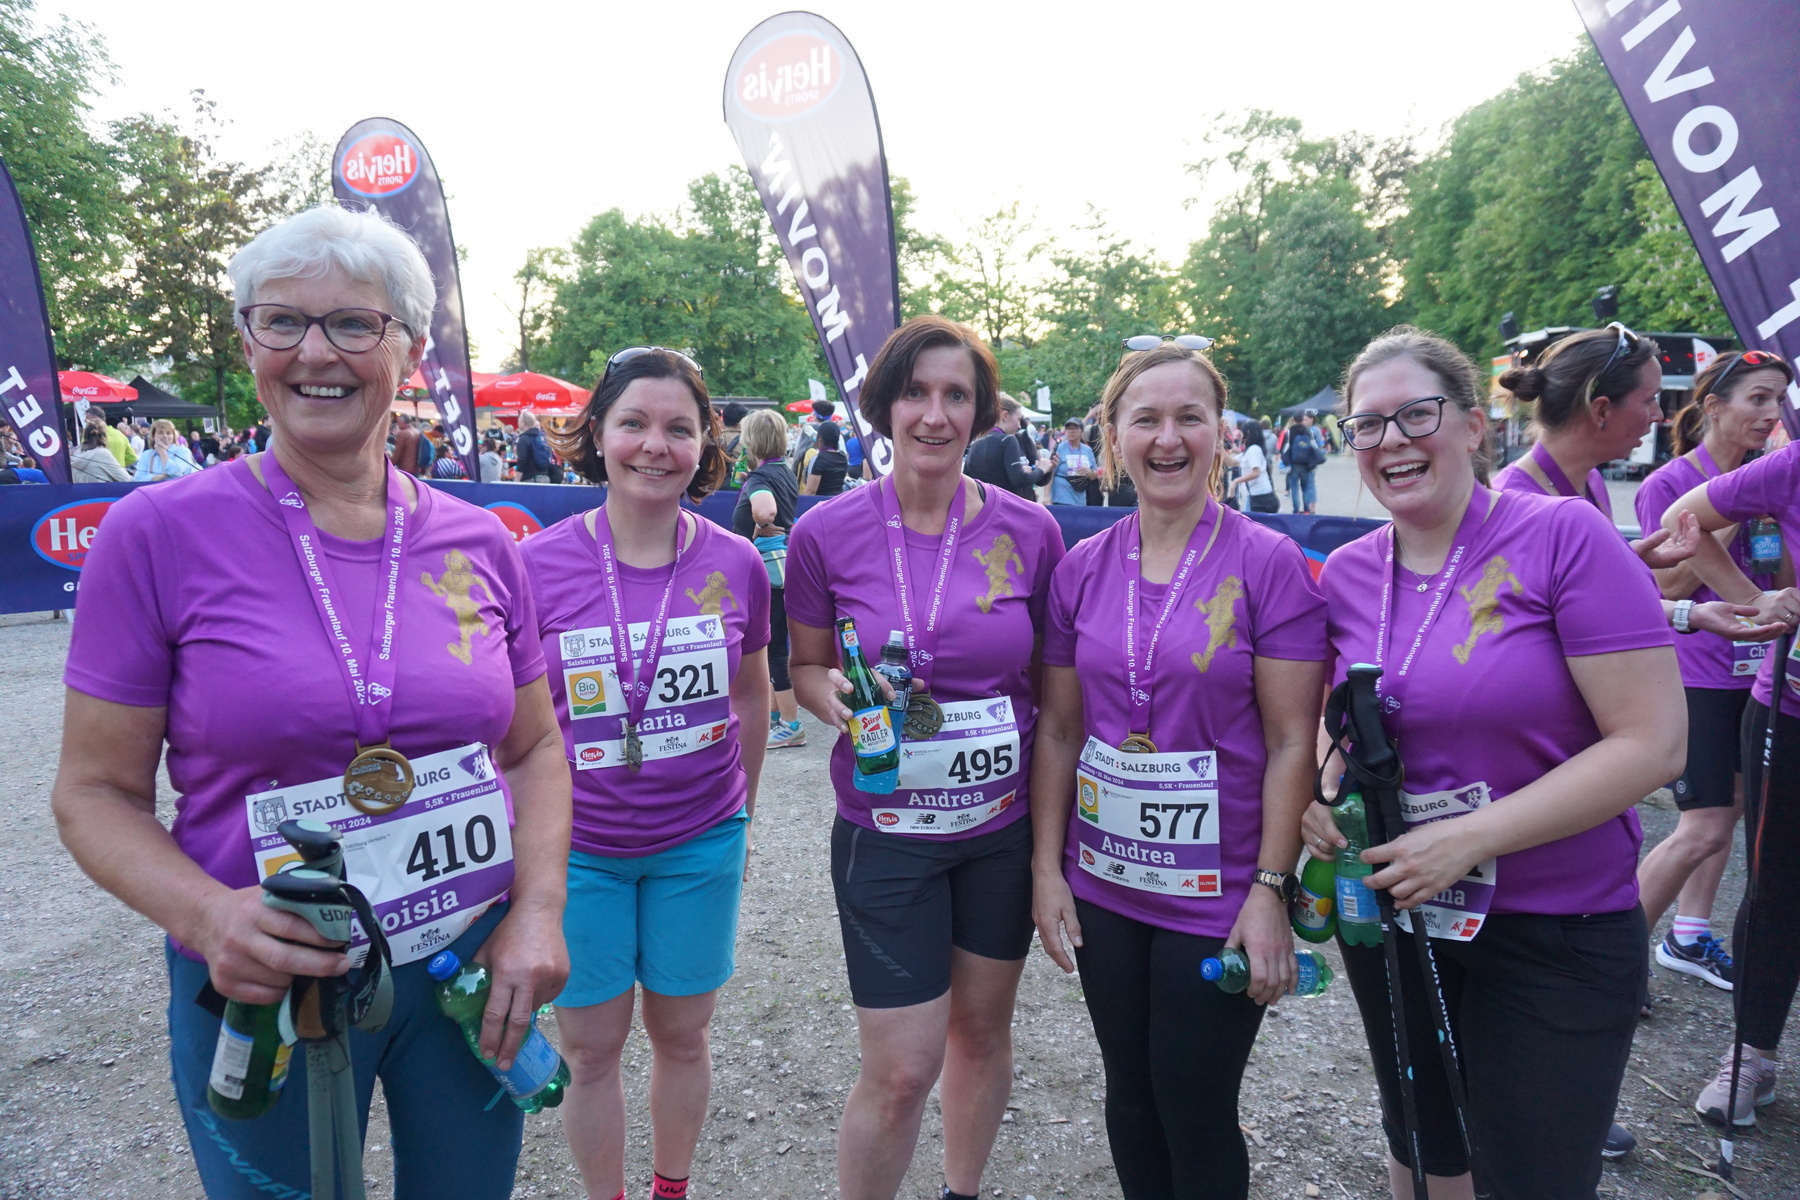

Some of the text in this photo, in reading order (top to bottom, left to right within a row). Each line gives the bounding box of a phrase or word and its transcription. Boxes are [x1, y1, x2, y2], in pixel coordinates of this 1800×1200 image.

[72, 386, 98, 395] Coca-Cola
[535, 393, 557, 401] Coca-Cola
[48, 518, 98, 551] He
[299, 534, 325, 586] Salzburger
[602, 544, 611, 559] 2024
[605, 561, 614, 573] Mai
[926, 517, 959, 632] Salzburger Frauenlauf 10. Mai 2024
[379, 506, 404, 661] Salzburger Frauenlauf 10. Mai 2024
[609, 585, 622, 622] Frauenlauf
[894, 547, 905, 584] Salzburger
[900, 584, 912, 622] Frauenlauf
[907, 635, 917, 649] Mai
[1127, 580, 1136, 617] Salzburger
[319, 588, 347, 640] Frauenlauf
[1144, 549, 1197, 671] Salzburger Frauenlauf 10. Mai 2024
[1398, 545, 1466, 676] Salzburger Frauenlauf 10. Mai 2024
[617, 623, 628, 663] Salzburger
[646, 624, 661, 664] Salzburger
[1127, 617, 1135, 657] Frauenlauf
[340, 642, 353, 657] 10.
[690, 642, 723, 650] Frauenlauf
[346, 659, 361, 677] Mai
[567, 658, 595, 667] Salzburg
[1127, 658, 1136, 670] 10.
[578, 681, 596, 692] Bio
[657, 662, 719, 703] 321
[861, 713, 881, 730] Stiegl
[981, 724, 1013, 735] Frauenlauf
[698, 733, 710, 743] AK
[861, 728, 889, 744] RADLER
[582, 751, 603, 760] Hervis
[659, 742, 687, 752] FESTINA
[948, 744, 1013, 784] 495
[1095, 750, 1115, 767] STADT
[1121, 761, 1181, 773] SALZBURG
[1112, 777, 1124, 786] 2024
[425, 781, 498, 809] 5,5K Frauenlauf
[908, 791, 984, 808] Andrea
[1083, 788, 1093, 799] Bio
[293, 793, 347, 816] STADT
[988, 805, 998, 815] AK
[348, 816, 372, 829] 2024
[878, 815, 898, 823] Hervis
[950, 817, 977, 827] FESTINA
[1139, 802, 1209, 840] 577
[406, 814, 497, 882] 410
[1101, 835, 1176, 865] Andrea
[1112, 873, 1130, 883] balance
[1139, 876, 1167, 887] FESTINA
[1181, 879, 1195, 888] AK
[350, 889, 460, 944] Aoisia
[1450, 921, 1462, 931] AK
[411, 932, 450, 953] FESTINA
[839, 902, 913, 978] DYNAFIT
